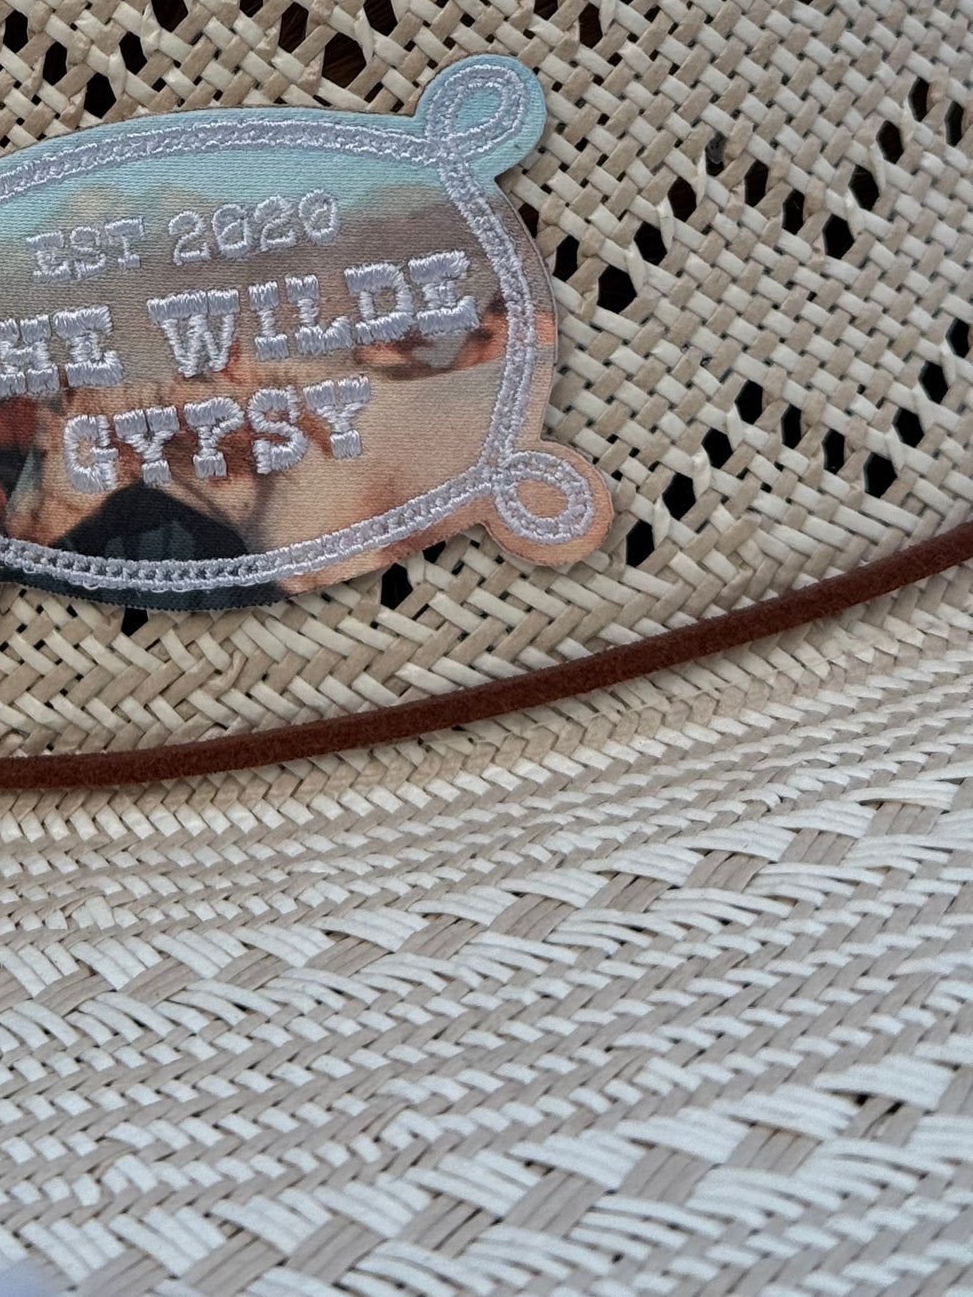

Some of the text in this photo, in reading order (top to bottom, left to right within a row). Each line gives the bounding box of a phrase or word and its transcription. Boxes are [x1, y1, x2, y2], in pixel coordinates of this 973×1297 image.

[26, 188, 342, 282] EST 2020
[146, 249, 480, 379] WILDE
[63, 374, 371, 495] GYPSY
